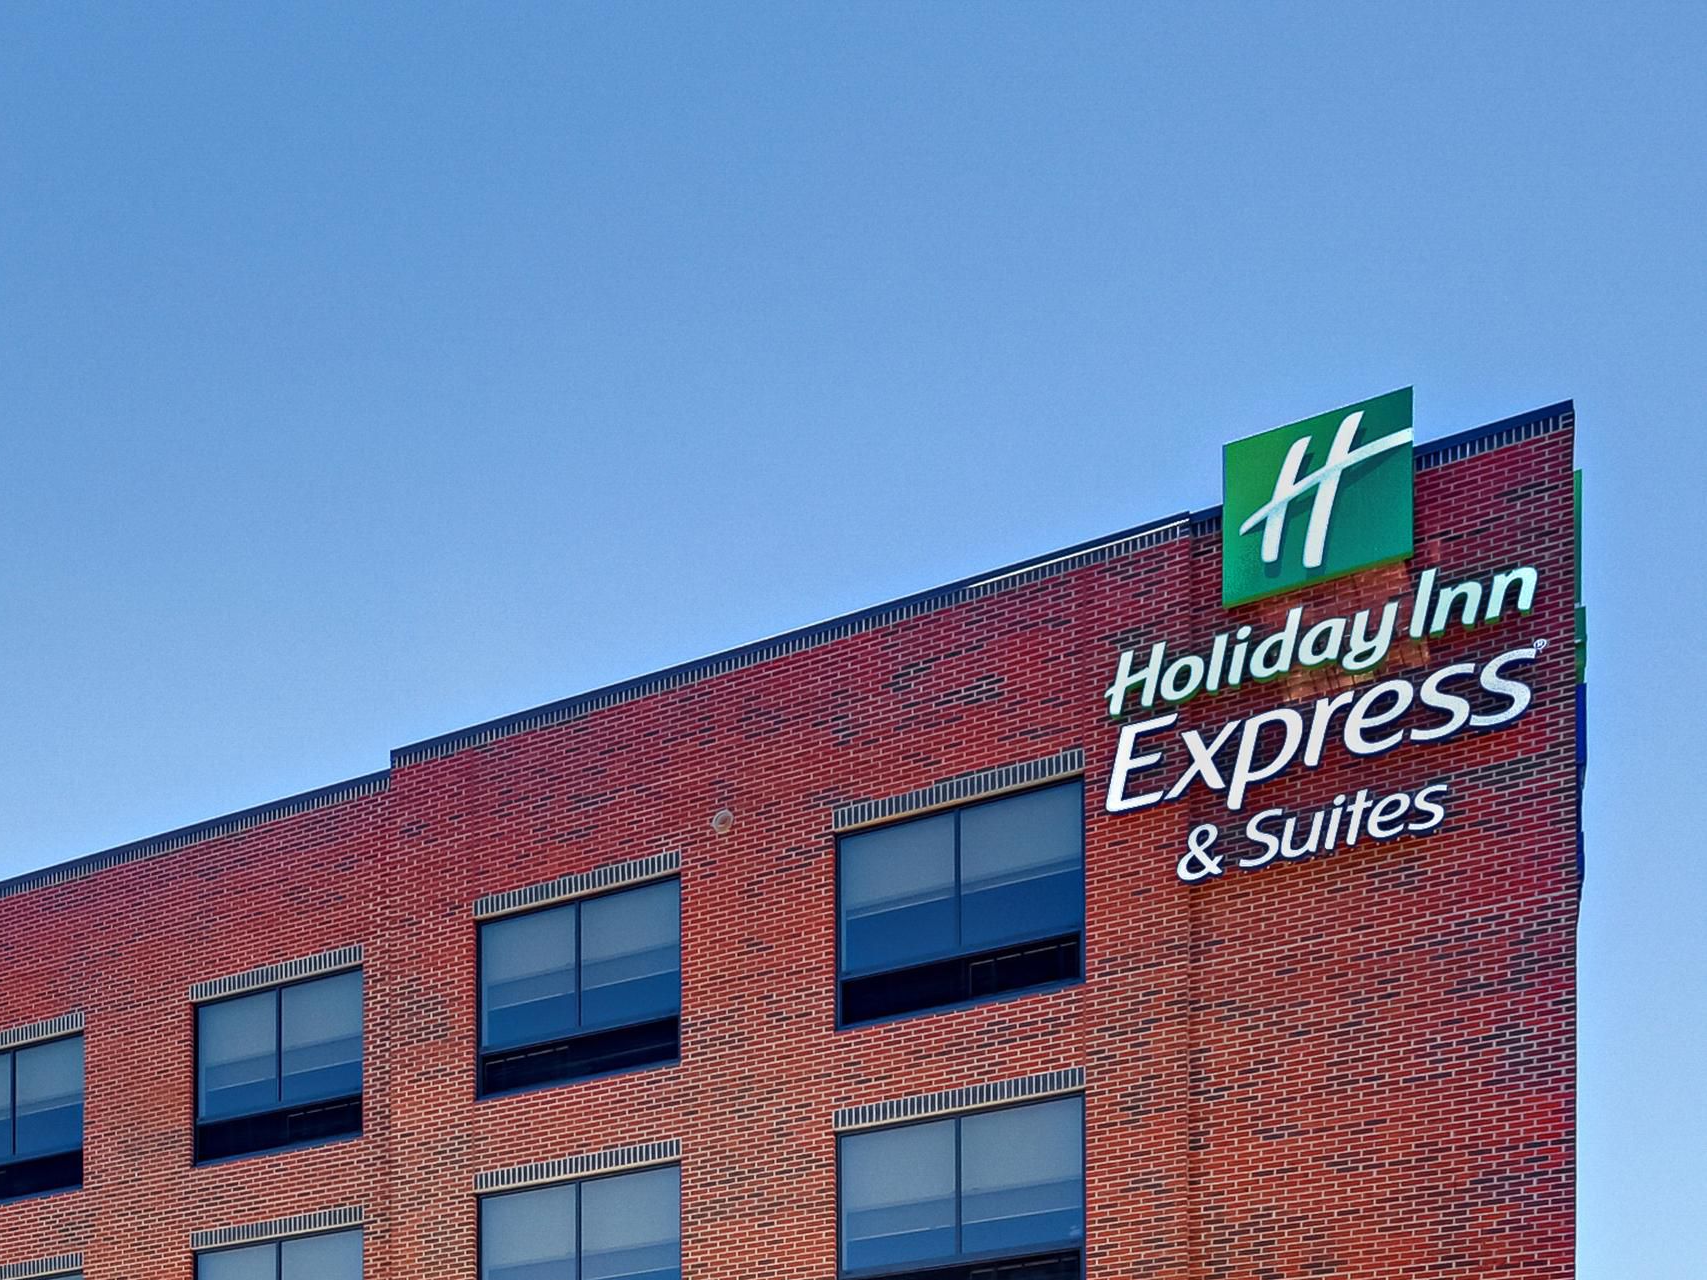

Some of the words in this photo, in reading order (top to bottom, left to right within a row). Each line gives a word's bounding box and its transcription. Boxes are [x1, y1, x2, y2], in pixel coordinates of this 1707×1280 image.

[1239, 410, 1414, 568] H
[1104, 602, 1399, 716] Holiday
[1409, 565, 1538, 638] Inn
[1105, 647, 1537, 812] Express
[1177, 824, 1224, 882] &
[1239, 784, 1448, 867] Suites
